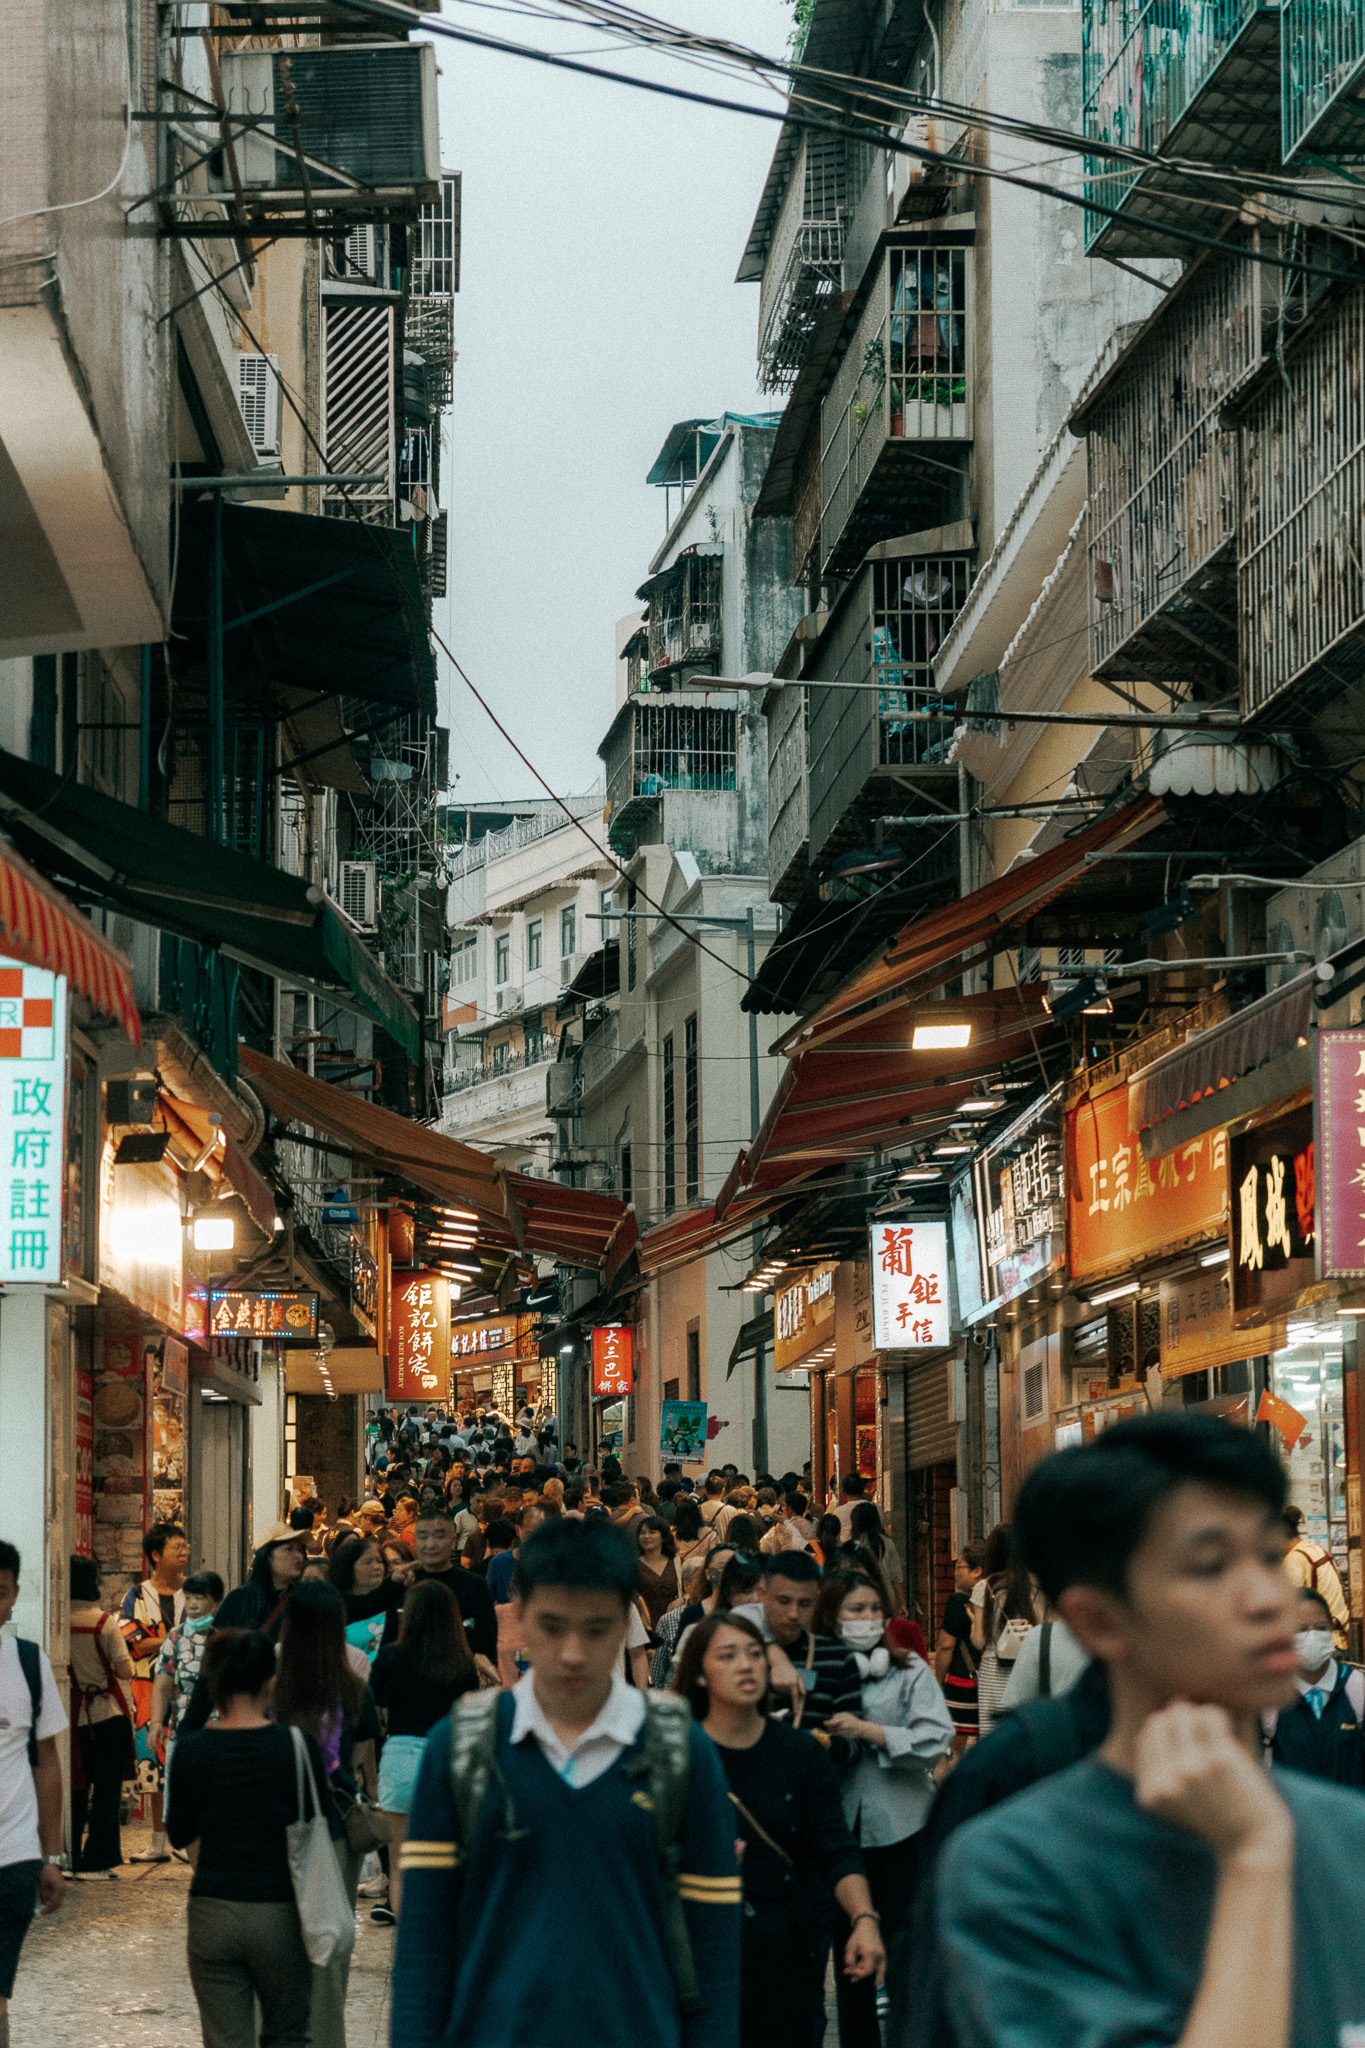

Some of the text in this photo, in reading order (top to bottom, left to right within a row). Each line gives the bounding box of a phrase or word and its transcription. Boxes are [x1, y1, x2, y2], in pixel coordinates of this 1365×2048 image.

[9, 1078, 51, 1270] 政府註冊
[401, 1281, 438, 1376] 鉅記餅家
[603, 1330, 620, 1377] 大三巴
[598, 1380, 629, 1393] 餅家
